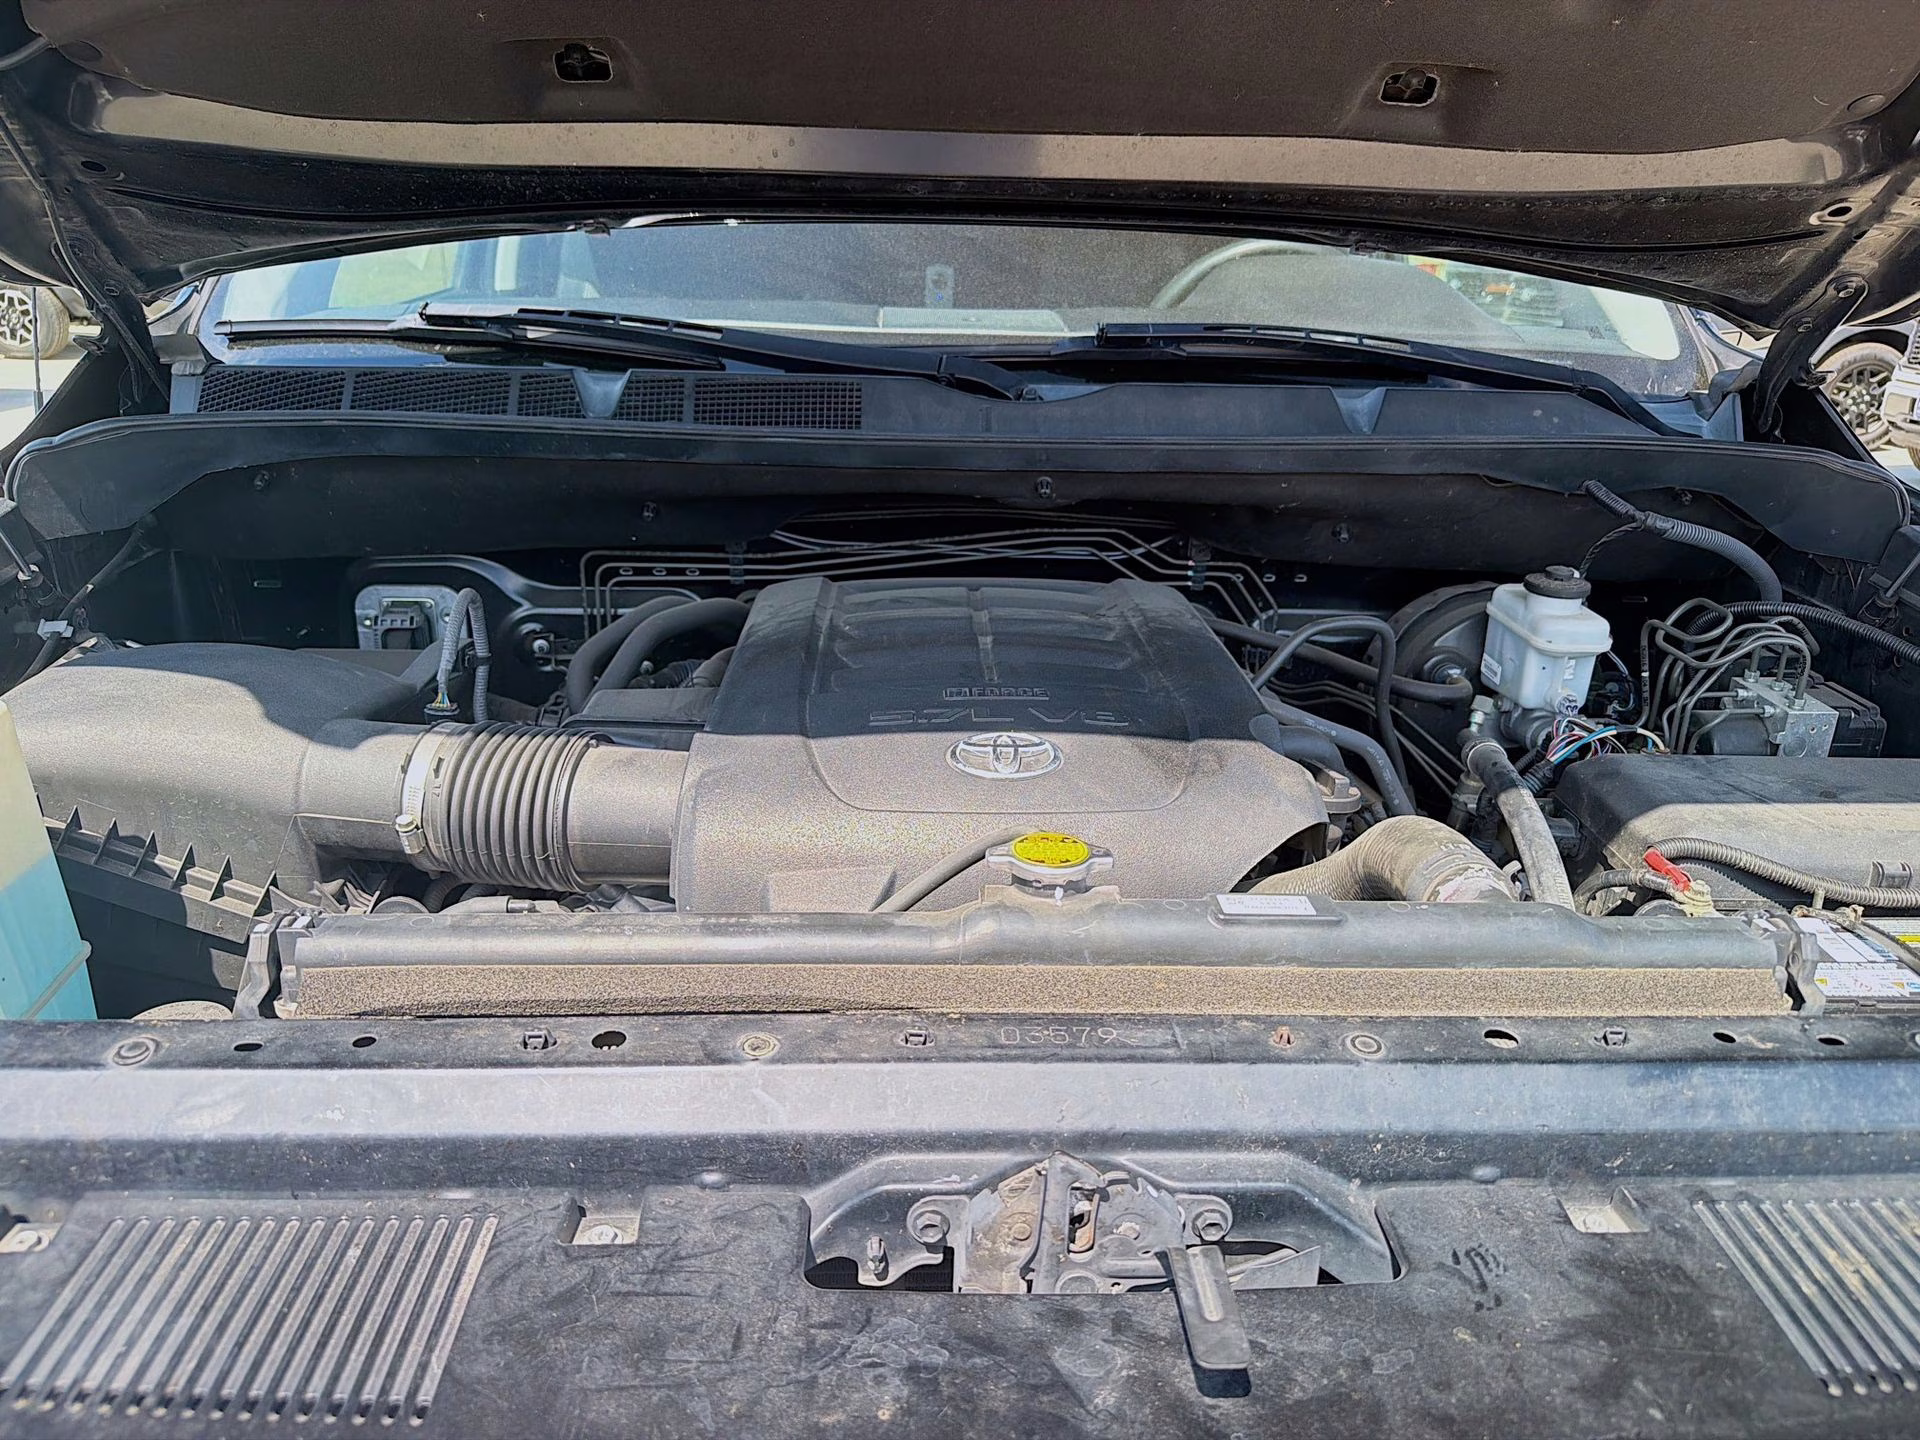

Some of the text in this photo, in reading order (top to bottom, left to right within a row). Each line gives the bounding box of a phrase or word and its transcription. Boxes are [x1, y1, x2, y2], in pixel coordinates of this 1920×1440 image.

[869, 706, 1130, 727] 5.7L V8
[1000, 1025, 1118, 1045] 03579
